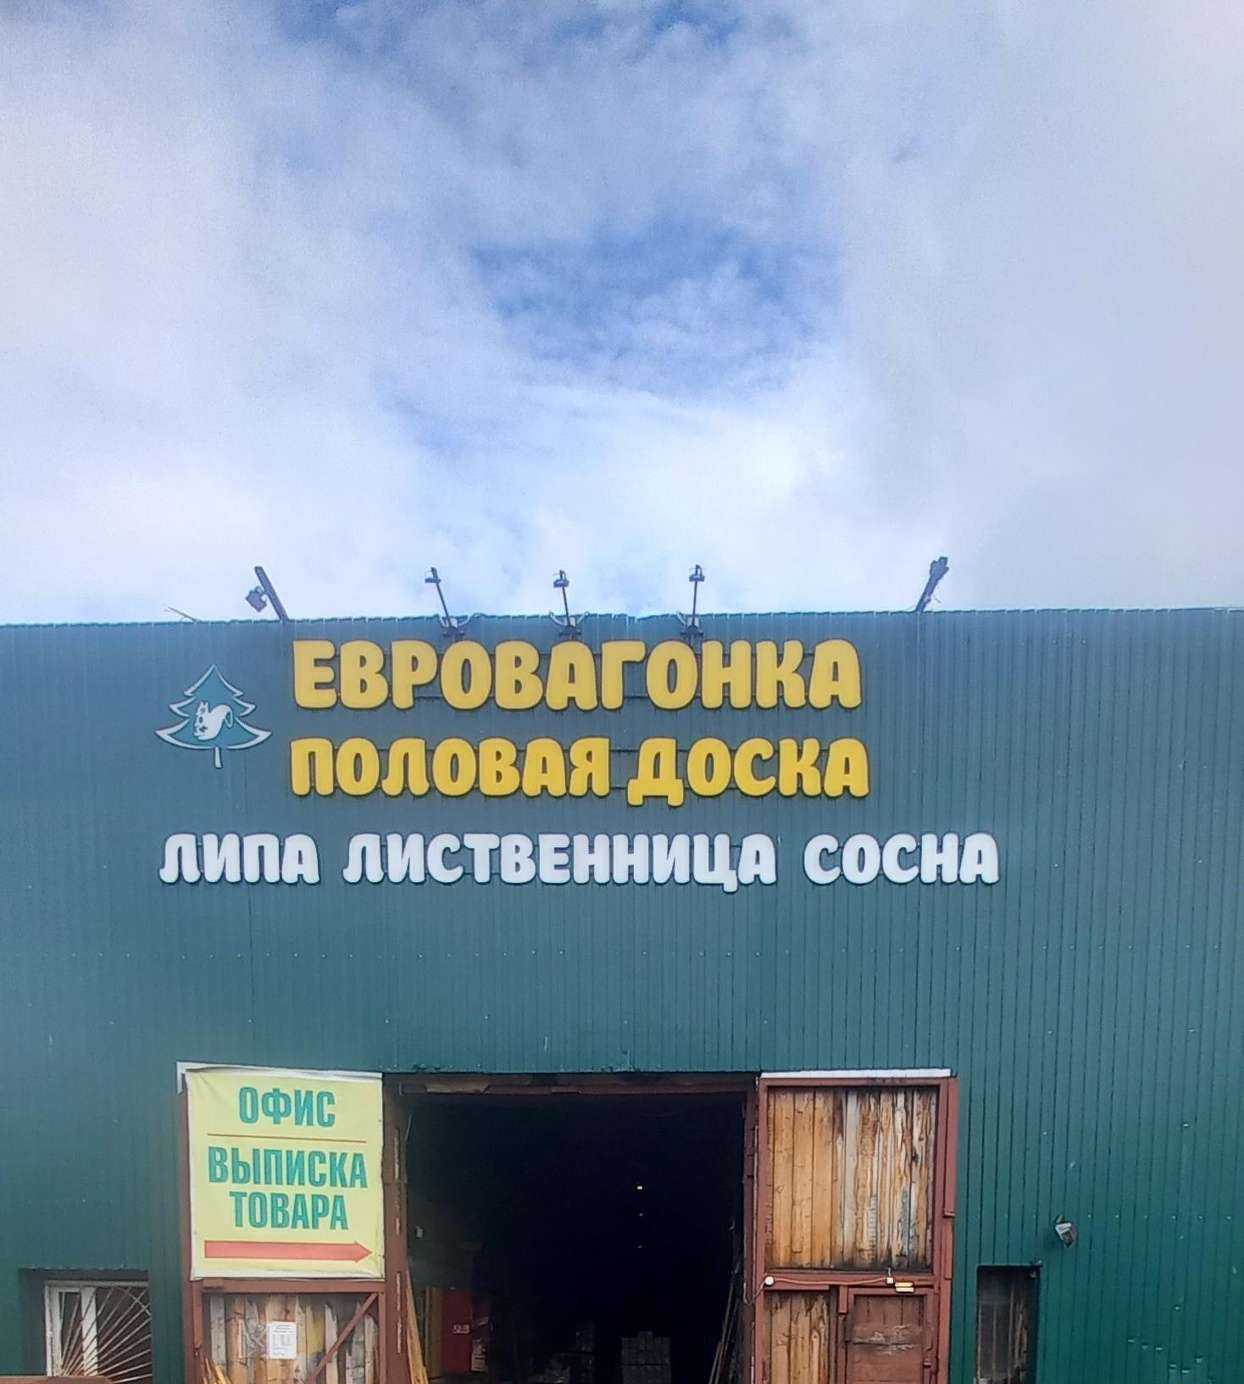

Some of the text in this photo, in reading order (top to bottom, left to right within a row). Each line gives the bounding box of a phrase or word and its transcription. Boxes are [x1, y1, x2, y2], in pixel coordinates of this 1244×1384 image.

[291, 639, 862, 711] ЕВРОВАГОНКА
[290, 737, 871, 807] ПОЛОВАЯ ДОСКА
[159, 832, 1000, 893] ЛИПА ЛИСТВЕННИЦА СОСНА
[238, 1086, 336, 1127] ОФИС
[208, 1146, 368, 1188] ВЫПИСКА
[229, 1190, 349, 1230] ТОВАРА
